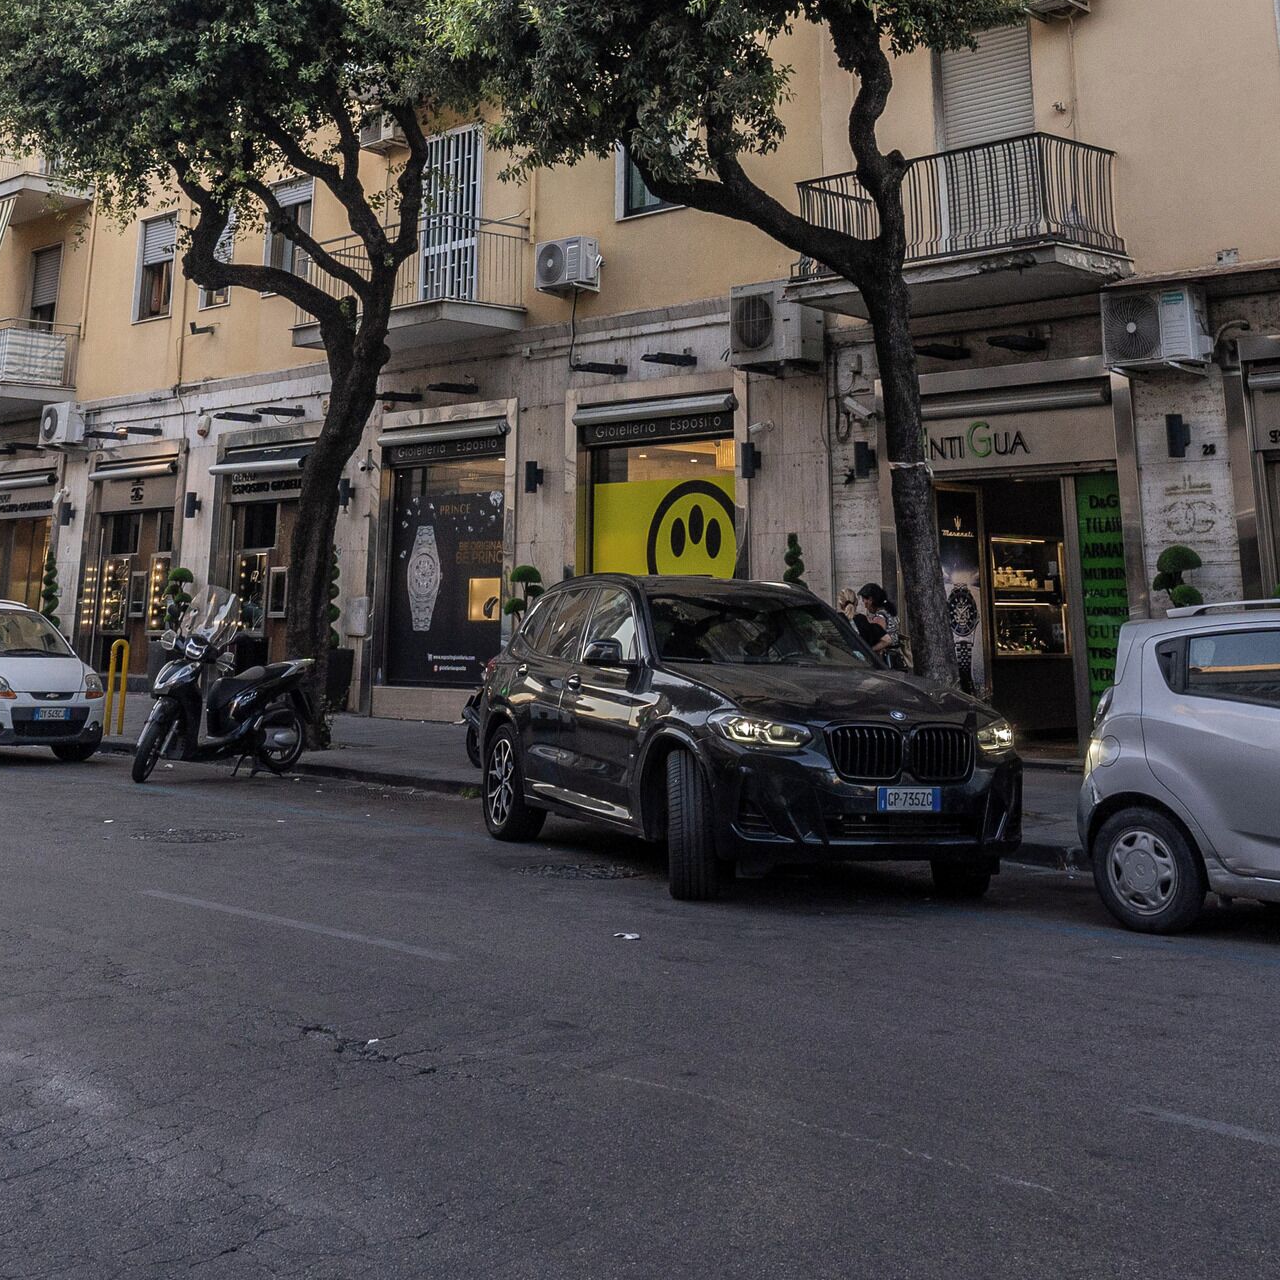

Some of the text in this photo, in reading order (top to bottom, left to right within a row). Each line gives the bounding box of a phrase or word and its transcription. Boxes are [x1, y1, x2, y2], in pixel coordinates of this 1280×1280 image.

[595, 414, 722, 439] Gioielleria Esposito
[397, 438, 498, 459] Gioielleria Esposito
[1202, 443, 1217, 456] 28
[440, 503, 471, 515] PRINCE
[1088, 494, 1118, 510] D&G
